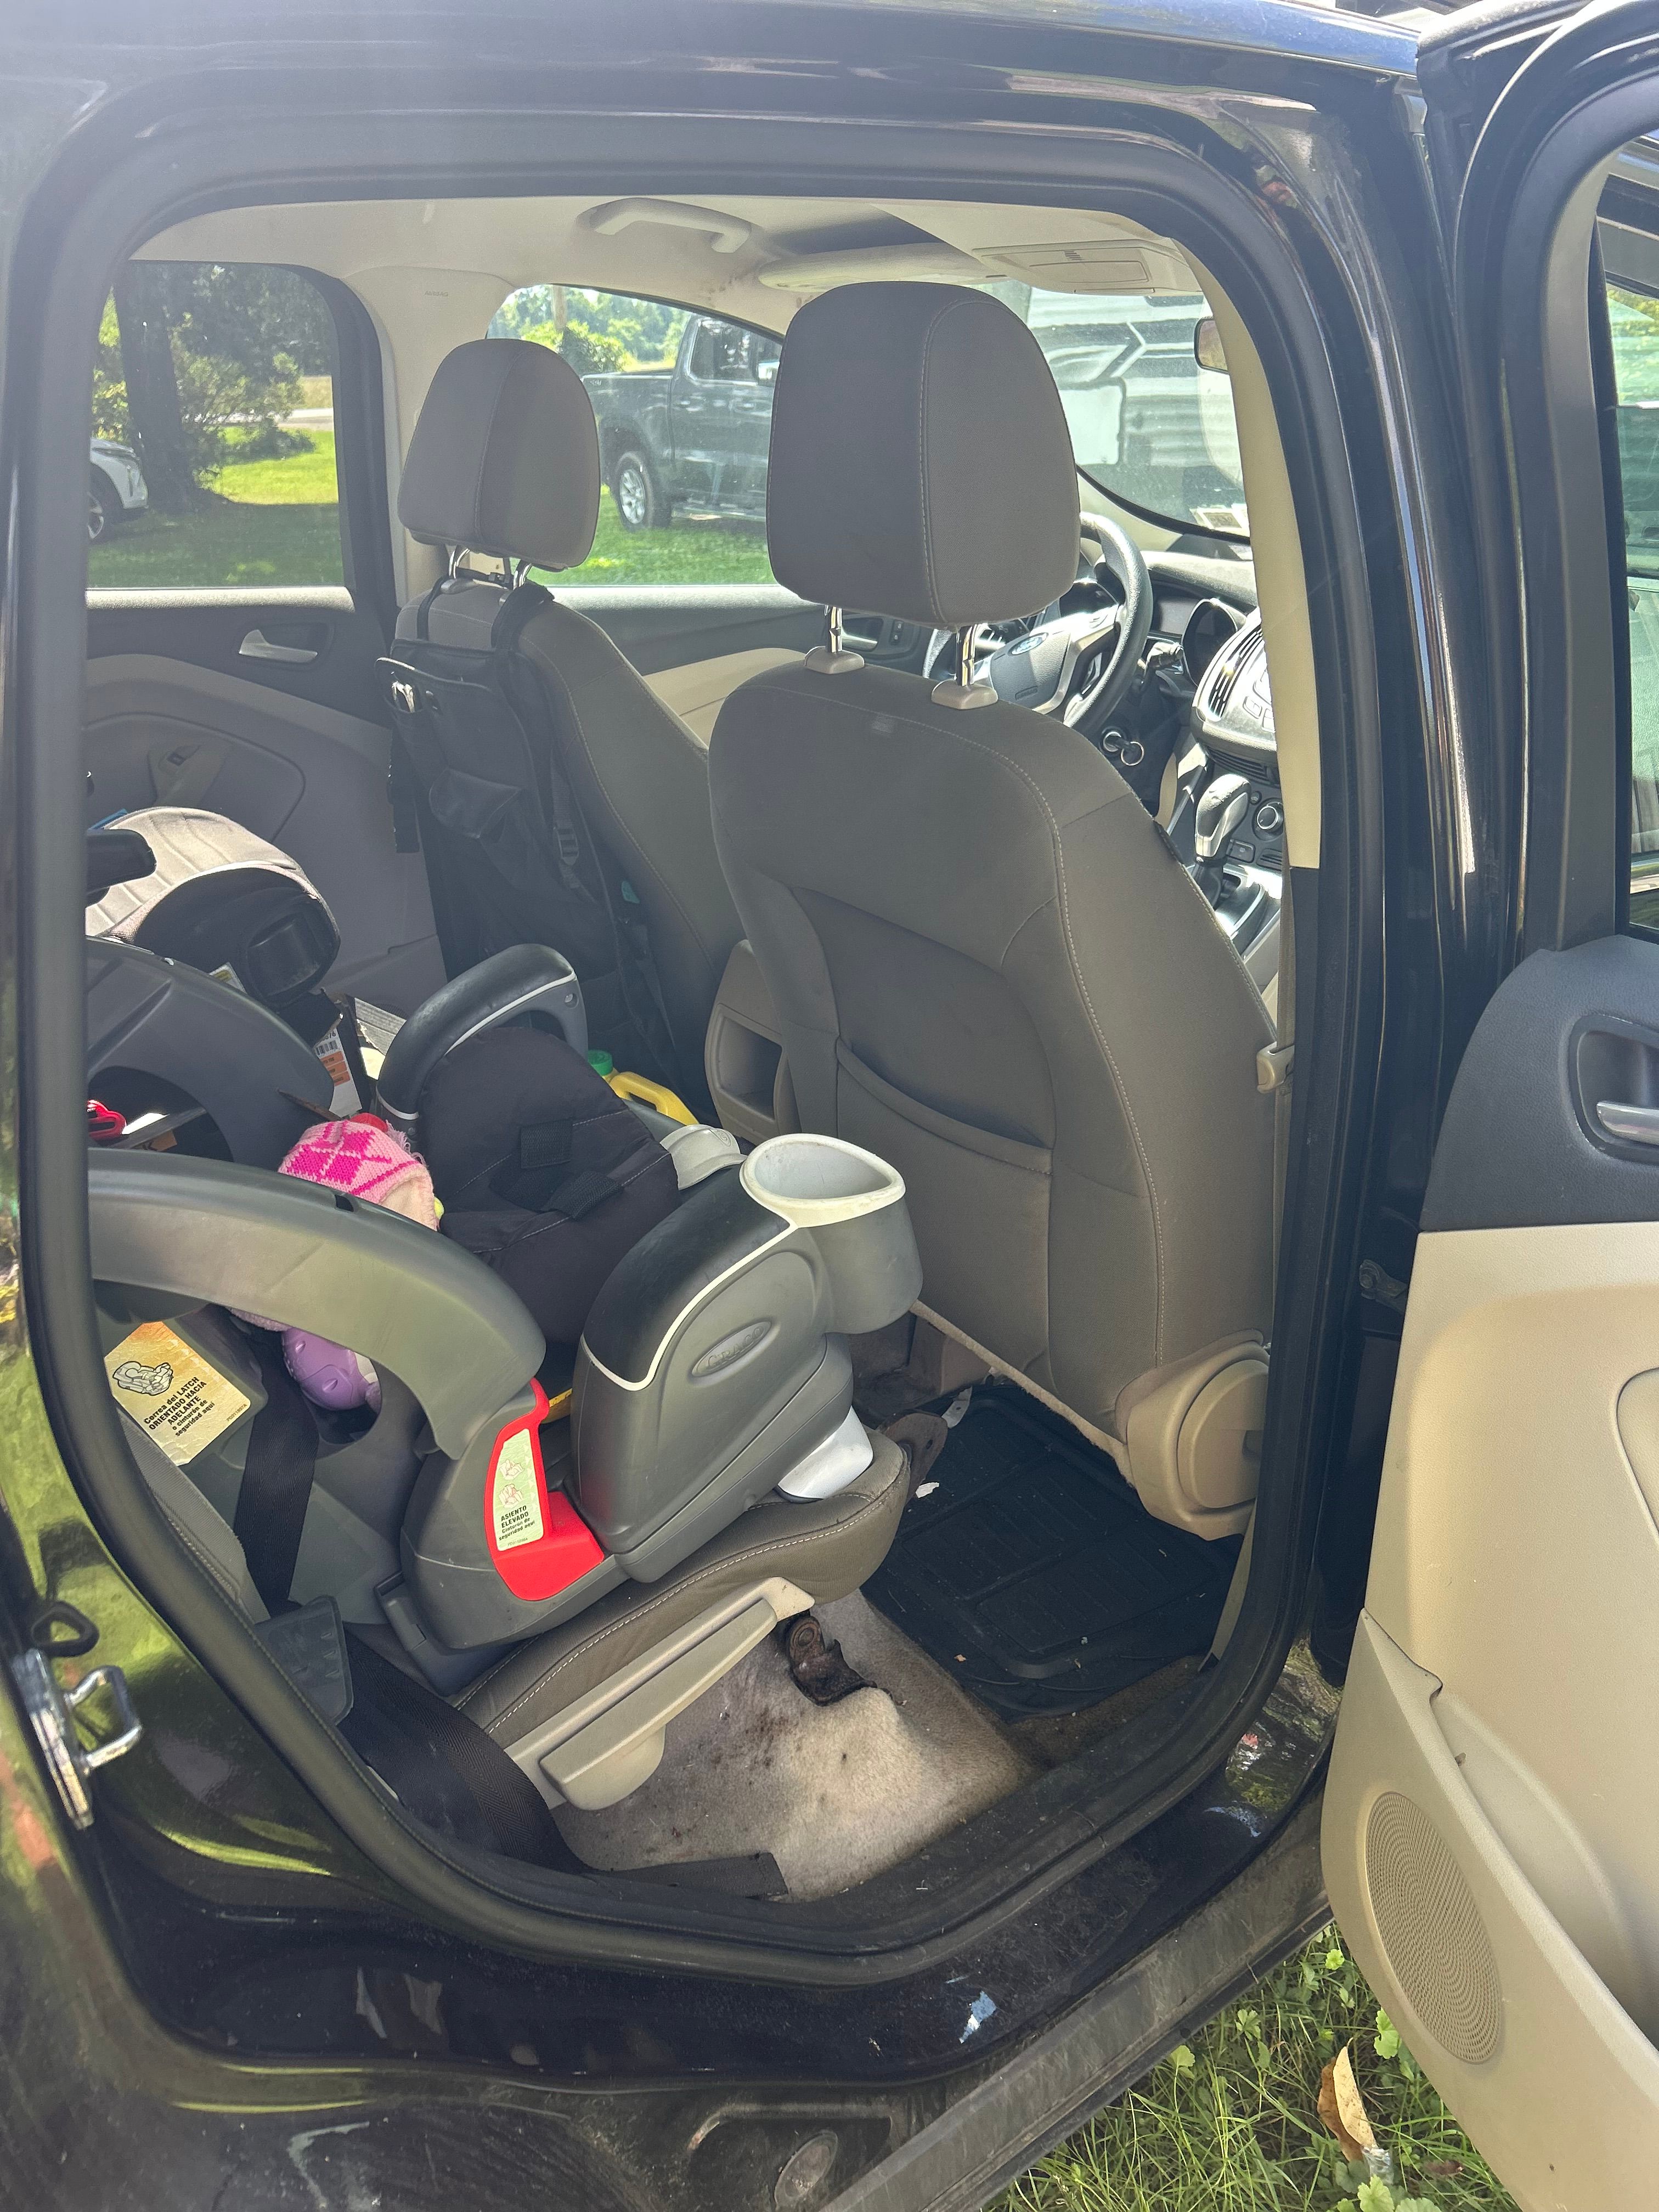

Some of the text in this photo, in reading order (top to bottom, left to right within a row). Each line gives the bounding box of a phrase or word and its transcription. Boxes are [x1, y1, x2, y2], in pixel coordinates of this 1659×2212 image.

[708, 1327, 764, 1366] GRACO
[144, 1376, 199, 1424] Correa del LATCH
[149, 1381, 207, 1430] ORIENTADO HACIA
[167, 1395, 201, 1425] ADELANTE
[175, 1401, 215, 1436] seguridad aquí
[177, 1407, 200, 1426] cinturón
[501, 1505, 527, 1521] ASIENTO
[501, 1511, 528, 1528] ELEVADO
[499, 1526, 523, 1541] seguridad
